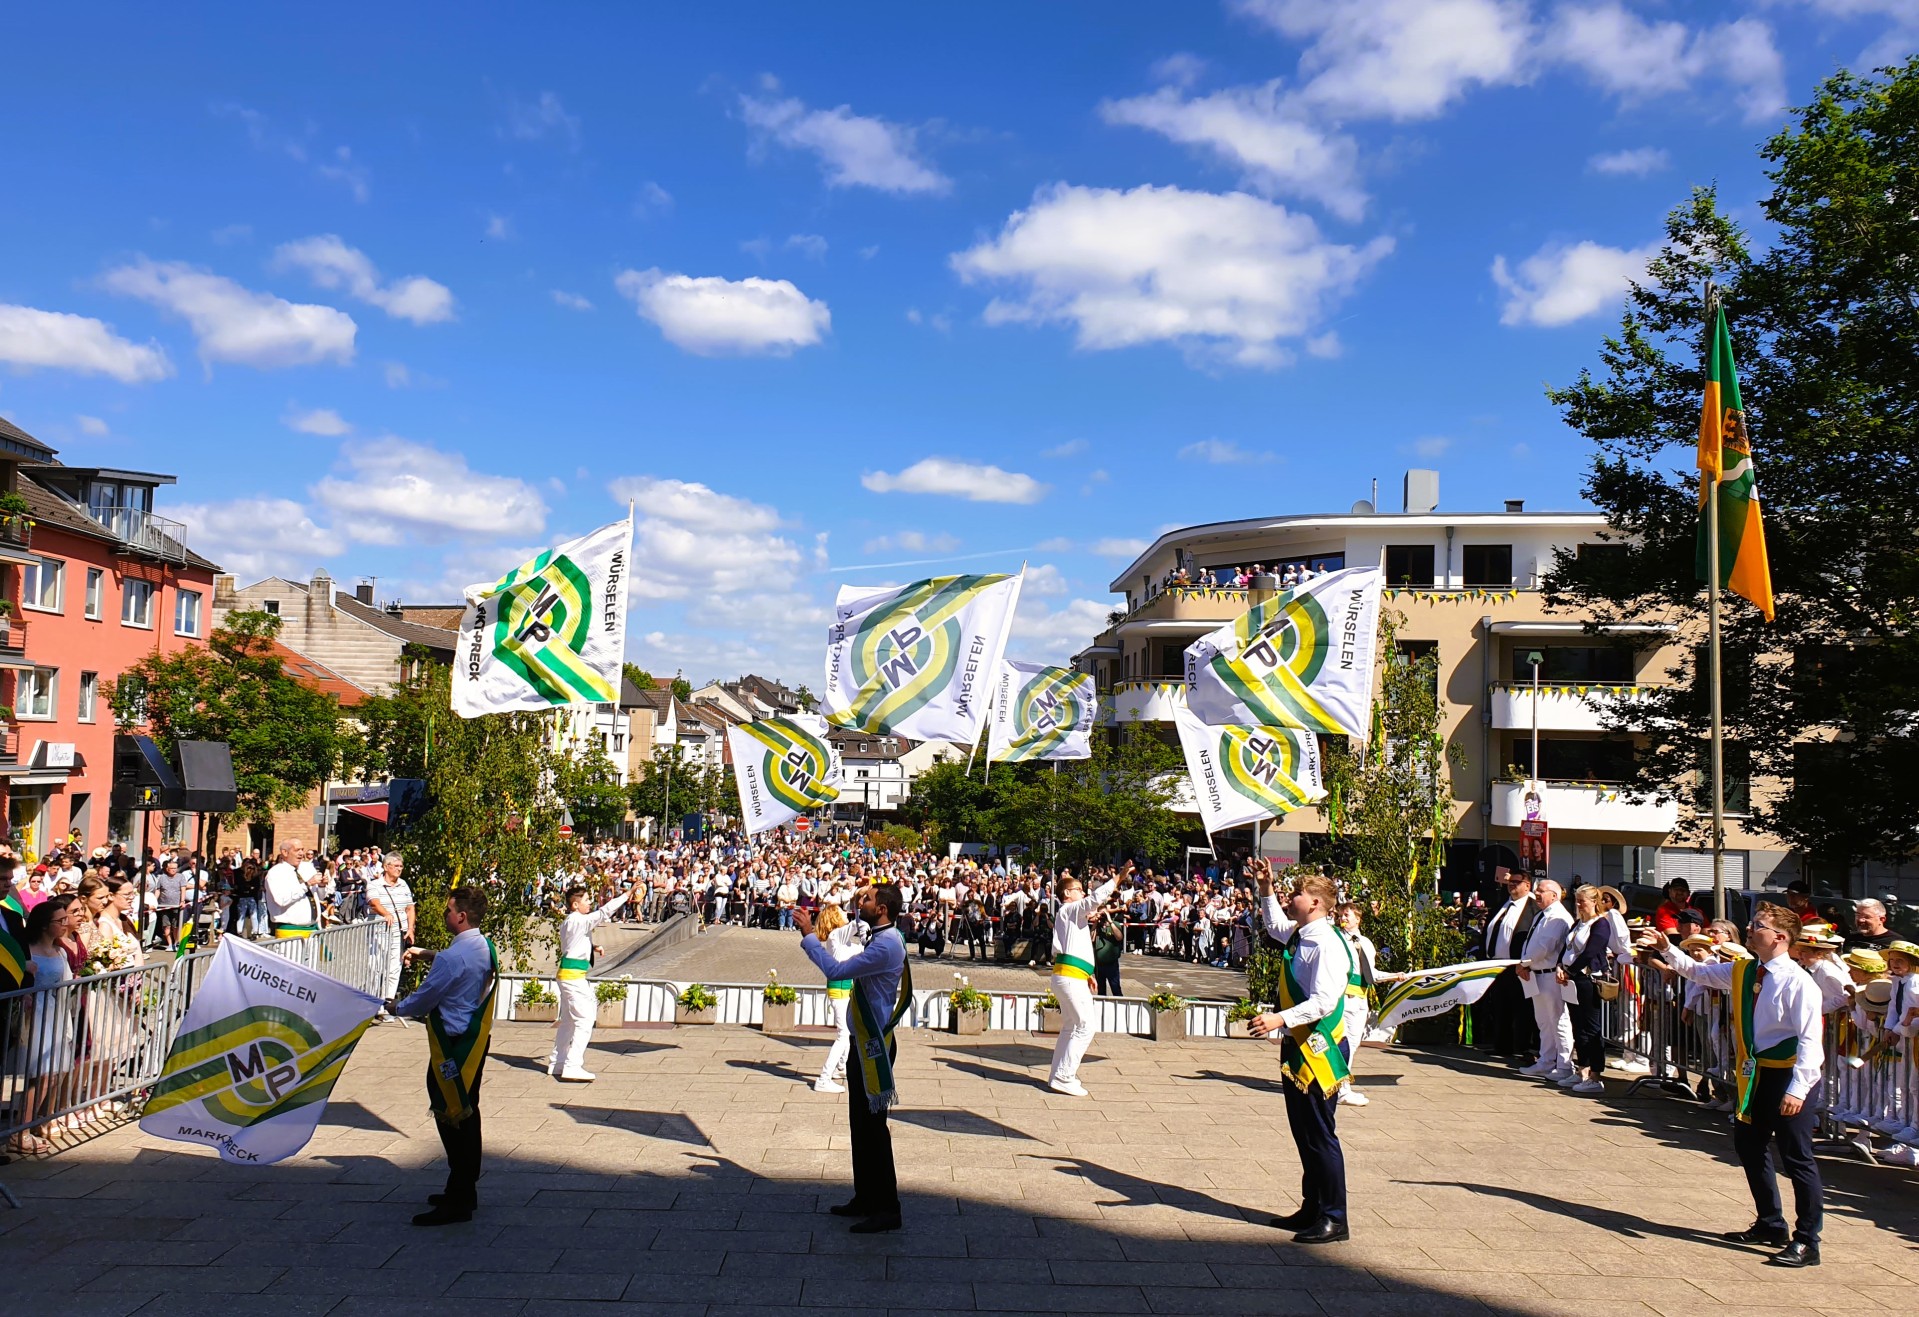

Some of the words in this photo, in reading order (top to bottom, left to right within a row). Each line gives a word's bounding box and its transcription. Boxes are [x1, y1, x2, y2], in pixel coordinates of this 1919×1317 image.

[605, 550, 623, 632] WÜRSELEN
[469, 603, 487, 682] RKT-PRECK
[1341, 589, 1363, 670] WÜRSELEN
[747, 765, 762, 817] WÜRSELEN
[1199, 749, 1222, 813] WÜRSELEN
[237, 961, 317, 1004] WÜRSELEN
